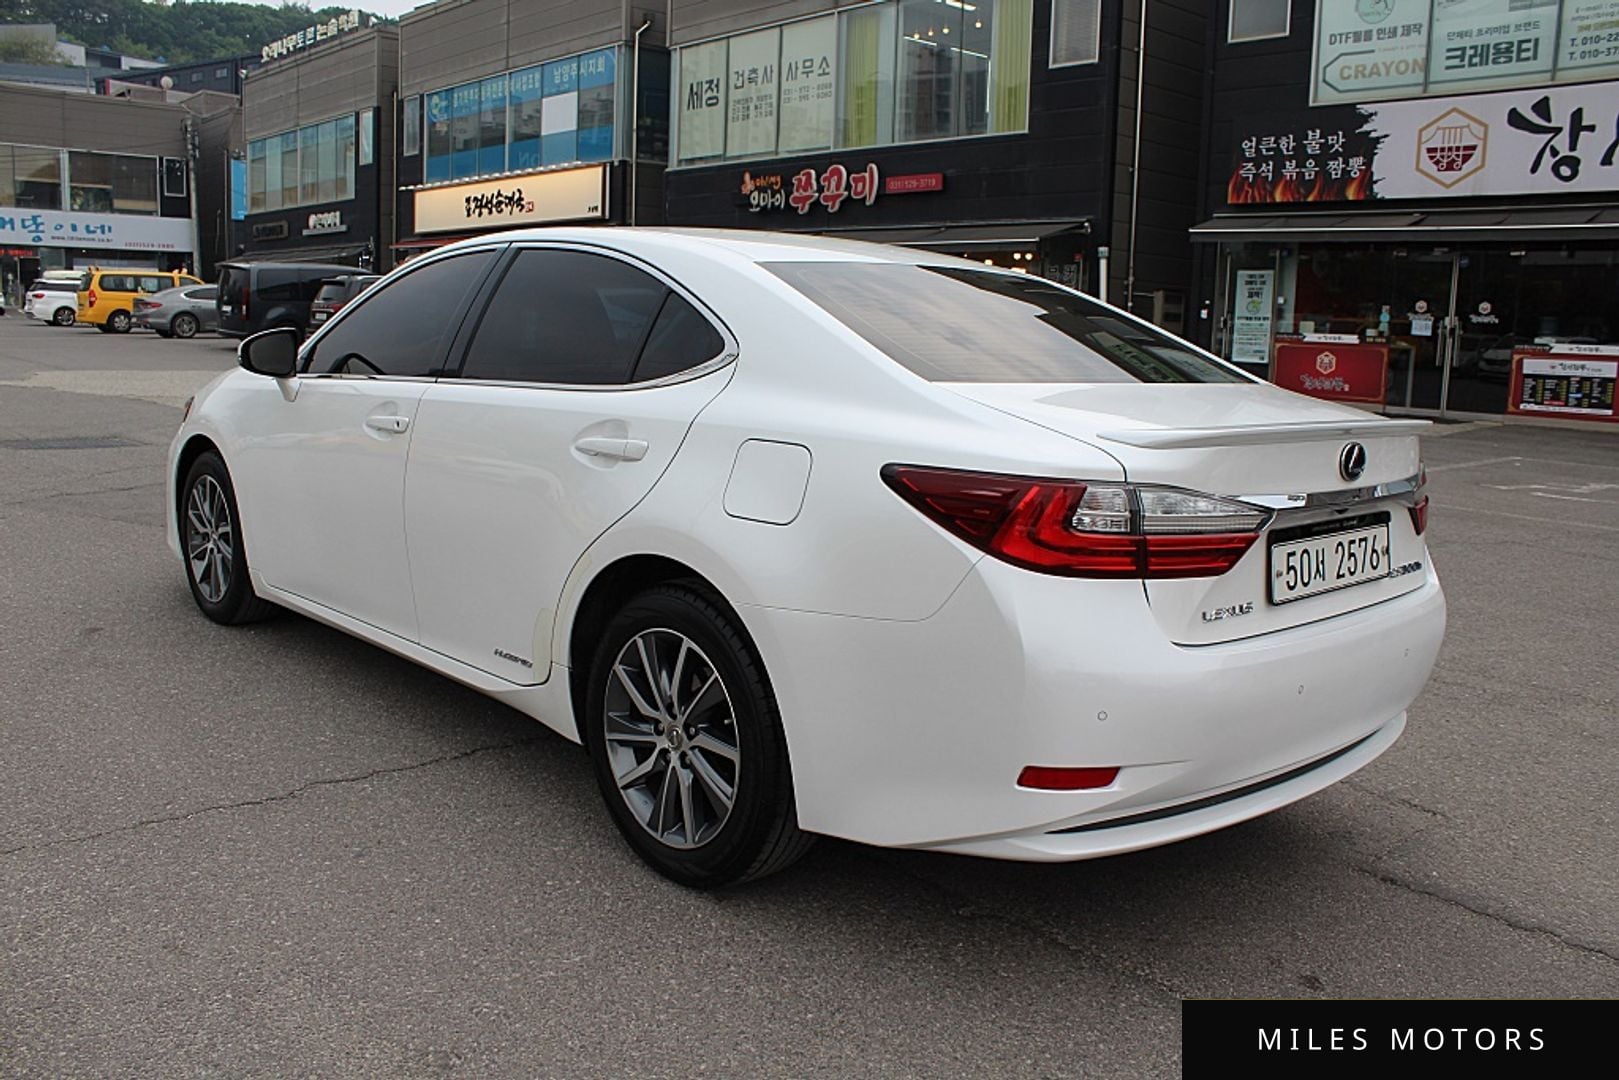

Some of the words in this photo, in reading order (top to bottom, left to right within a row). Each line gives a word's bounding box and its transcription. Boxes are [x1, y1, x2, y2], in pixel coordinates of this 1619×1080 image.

[1376, 26, 1398, 40] 인쇄
[1400, 23, 1423, 38] 제작
[1476, 24, 1510, 37] 프리미엄
[1514, 21, 1539, 33] 브랜드
[1445, 38, 1539, 70] 크레용티
[553, 56, 606, 84] 남양주시지회
[1340, 57, 1427, 80] CRAYON
[687, 78, 720, 111] 세정
[734, 64, 773, 90] 건축사
[785, 56, 831, 82] 사무소
[1242, 134, 1296, 157] 얼큰한
[1303, 129, 1346, 155] 불맛
[1240, 161, 1273, 182] 즉석
[1282, 159, 1319, 180] 볶음
[1326, 157, 1366, 179] 짬뽕
[749, 189, 786, 212] 오마이
[789, 163, 879, 215] 쭈꾸미
[1286, 548, 1325, 591] 50서
[1335, 534, 1380, 580] 2576
[1202, 601, 1254, 623] LEXUS
